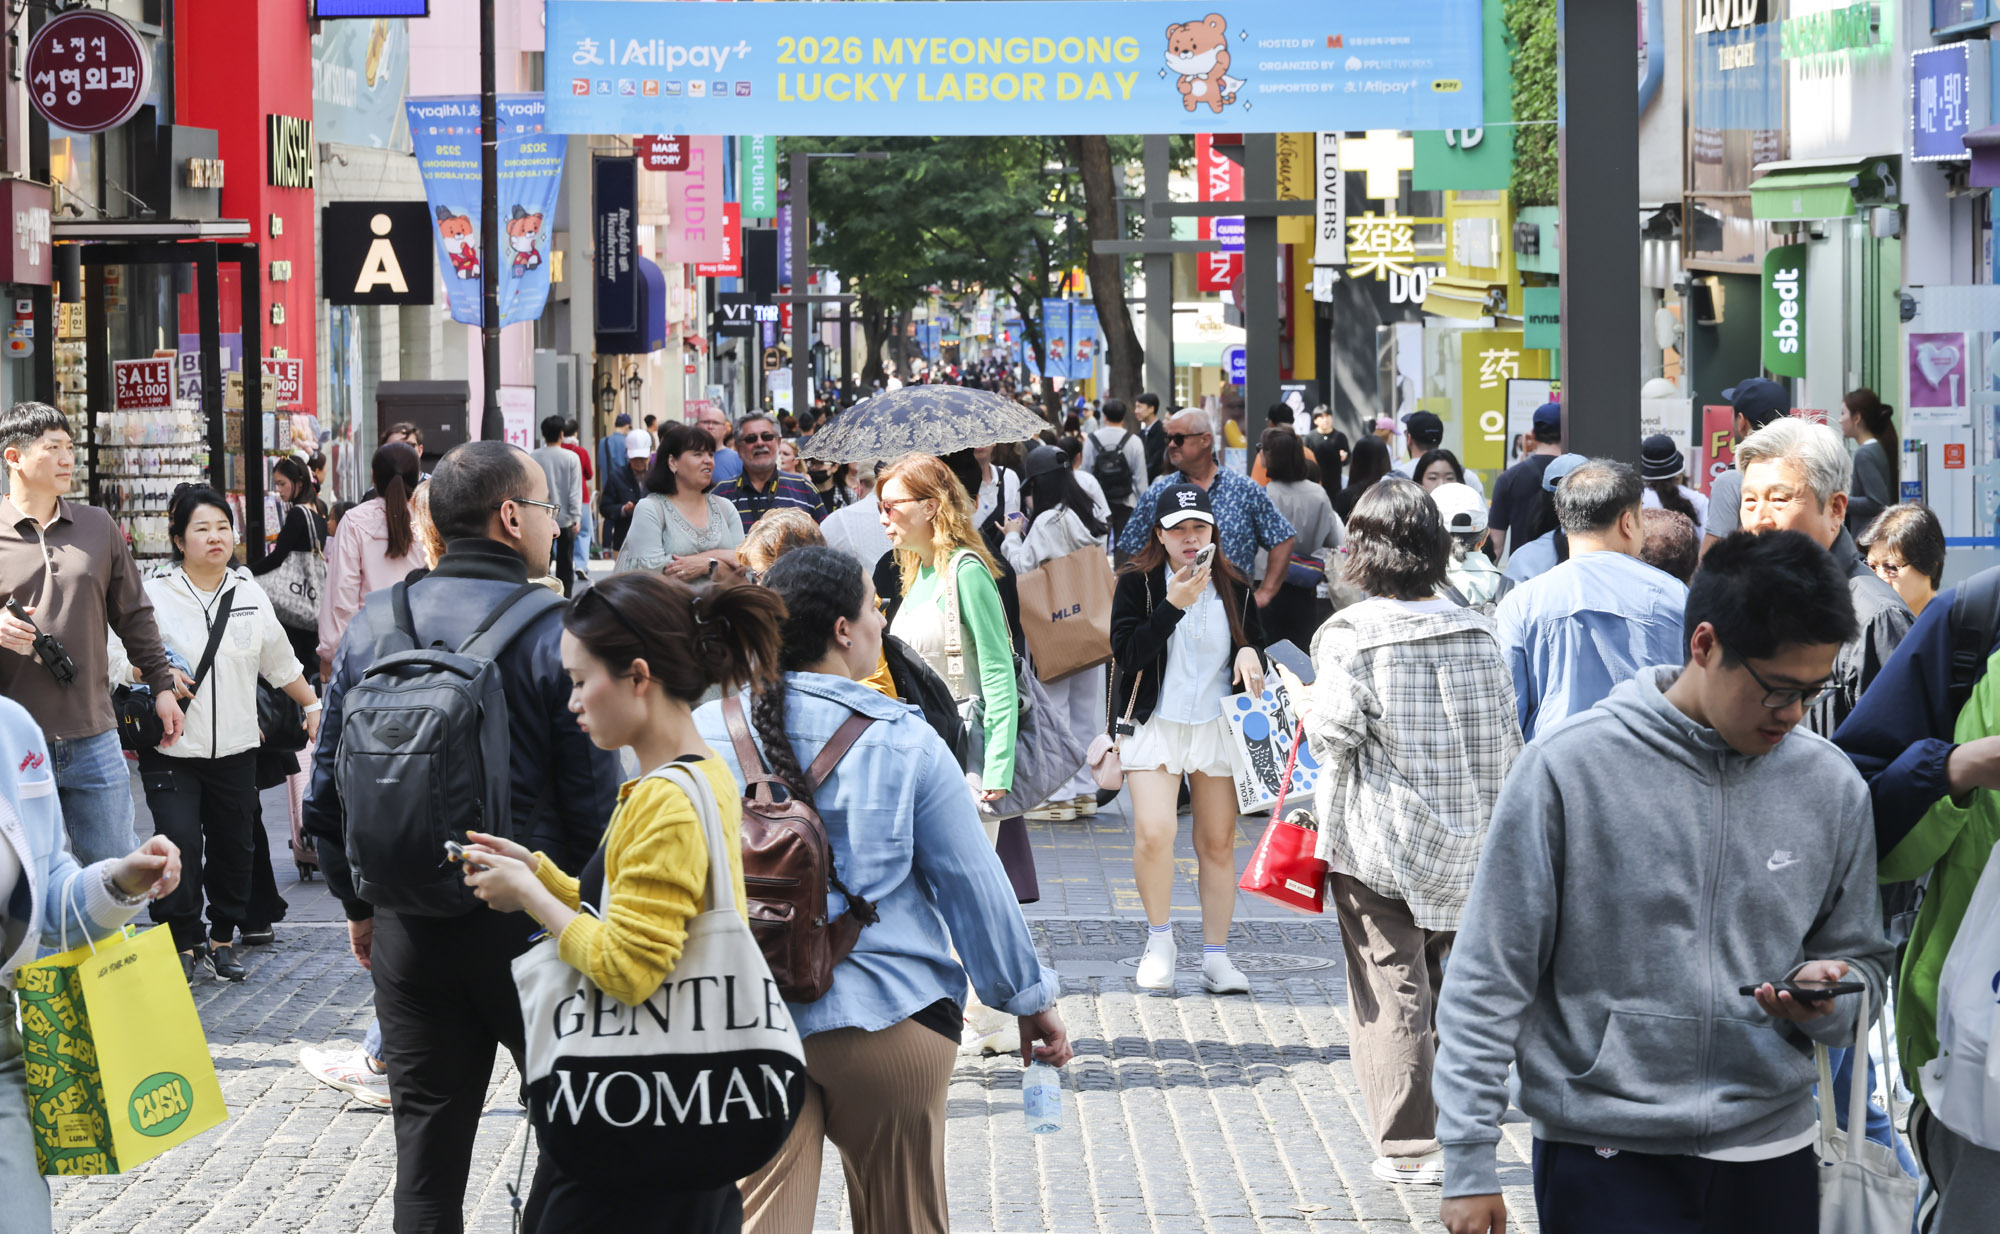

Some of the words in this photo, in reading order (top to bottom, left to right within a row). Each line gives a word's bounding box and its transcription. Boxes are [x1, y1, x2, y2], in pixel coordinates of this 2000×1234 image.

[52, 36, 106, 62] 노정식
[776, 36, 863, 64] 2026
[873, 36, 1140, 64] MYEONGDONG
[1258, 39, 1299, 48] HOSTED
[1302, 39, 1315, 48] BY
[1259, 61, 1319, 71] ORGANIZED
[1321, 60, 1335, 70] BY
[34, 66, 135, 107] 성형외과
[777, 72, 907, 102] LUCKY
[917, 72, 1046, 102] LABOR
[1056, 71, 1140, 101] DAY
[1259, 83, 1319, 93] SUPPORTED
[1321, 83, 1335, 93] BY
[272, 113, 314, 188] MISSHA
[651, 155, 680, 165] STORY
[652, 143, 680, 153] MASK
[751, 134, 766, 212] REPUBLIC
[1209, 135, 1231, 201] OYA
[684, 148, 706, 241] ETUDE
[1323, 153, 1337, 240] LOVERS
[618, 207, 631, 256] Rockfish
[1346, 210, 1416, 282] 藥
[699, 263, 716, 273] Drug
[717, 263, 738, 272] Store
[1772, 267, 1799, 354] sbedt
[118, 366, 167, 385] SALE
[262, 364, 297, 380] ALE
[1479, 348, 1520, 389] 药
[119, 387, 134, 399] 2EA
[289, 578, 317, 601] alo
[1051, 603, 1082, 623] MLB
[1240, 779, 1249, 807] SEOUL
[1772, 849, 1793, 862] NIKE
[554, 975, 787, 1039] GENTLE
[134, 1079, 188, 1130] LUSH
[546, 1064, 796, 1127] WOMAN
[69, 1134, 89, 1142] LUSH
